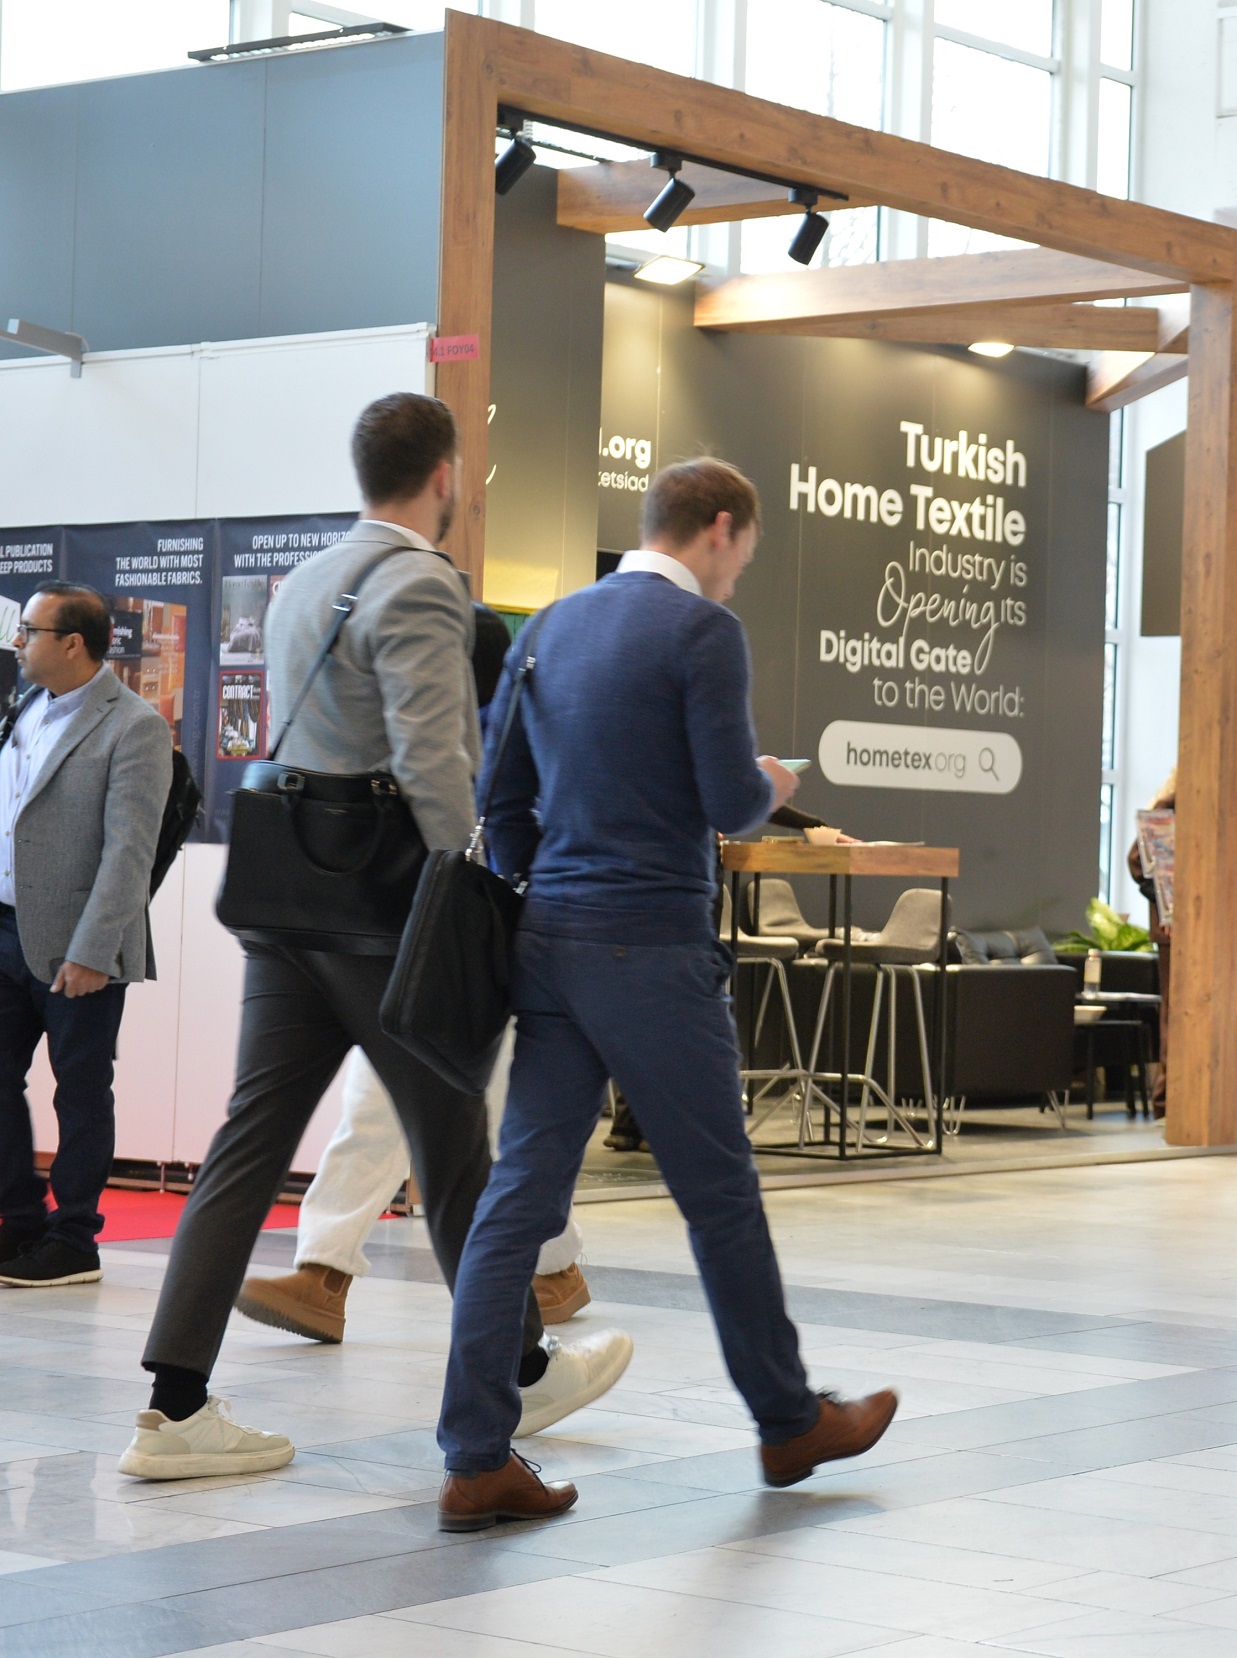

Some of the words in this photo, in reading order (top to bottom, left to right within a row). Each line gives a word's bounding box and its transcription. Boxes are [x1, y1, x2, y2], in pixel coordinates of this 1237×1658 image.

[599, 427, 652, 469] .org
[900, 421, 1026, 487] Turkish
[789, 463, 903, 527] Home
[910, 484, 1026, 546] Textile
[5, 543, 53, 558] PUBLICATION
[157, 537, 204, 553] FURNISHING
[252, 535, 274, 550] OPEN
[275, 534, 288, 548] UP
[289, 533, 299, 548] TO
[300, 532, 320, 547] NEW
[0, 561, 12, 575] EEP
[13, 559, 53, 574] PRODUCTS
[115, 556, 130, 571] THE
[131, 555, 159, 570] WORLD
[160, 554, 180, 569] WITH
[180, 554, 203, 568] MOST
[234, 553, 255, 568] WITH
[256, 552, 272, 567] THE
[909, 541, 1006, 590] Industry
[1010, 555, 1028, 588] is
[115, 571, 166, 587] FASHIONABLE
[167, 570, 203, 586] FABRICS.
[877, 561, 999, 676] Opening
[819, 630, 904, 673] Digital
[909, 638, 972, 675] Gate
[872, 677, 899, 707] to
[905, 677, 945, 711] the
[950, 681, 1025, 718] World:
